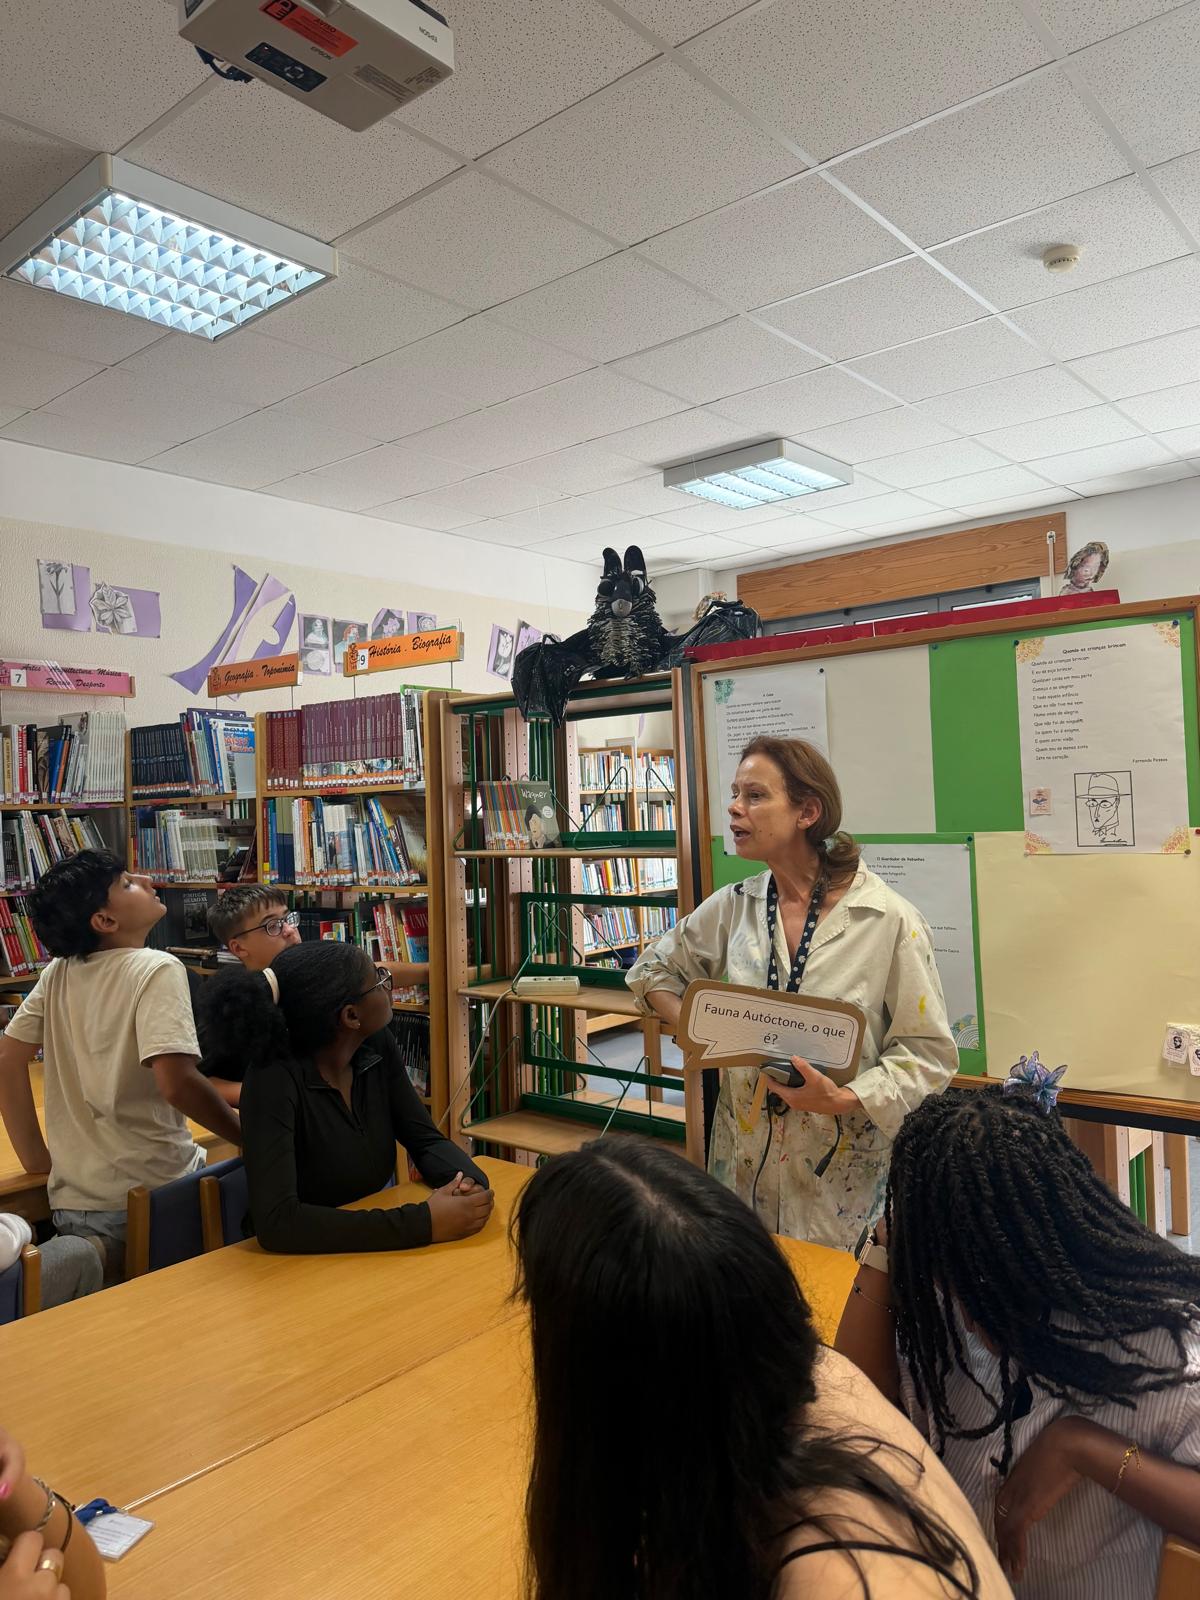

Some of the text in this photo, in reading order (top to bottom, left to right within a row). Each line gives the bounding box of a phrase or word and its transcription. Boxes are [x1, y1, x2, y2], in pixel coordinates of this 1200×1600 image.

[360, 633, 452, 665] 9 História Biografia
[15, 674, 22, 684] 7
[20, 664, 41, 672] Artes
[96, 668, 122, 676] Música
[76, 679, 106, 688] Desporto
[224, 662, 295, 686] Geografia Toponímia
[521, 788, 547, 802] Wagner
[704, 1003, 846, 1038] Fauna Autóctone, o que
[764, 1033, 778, 1045] é?
